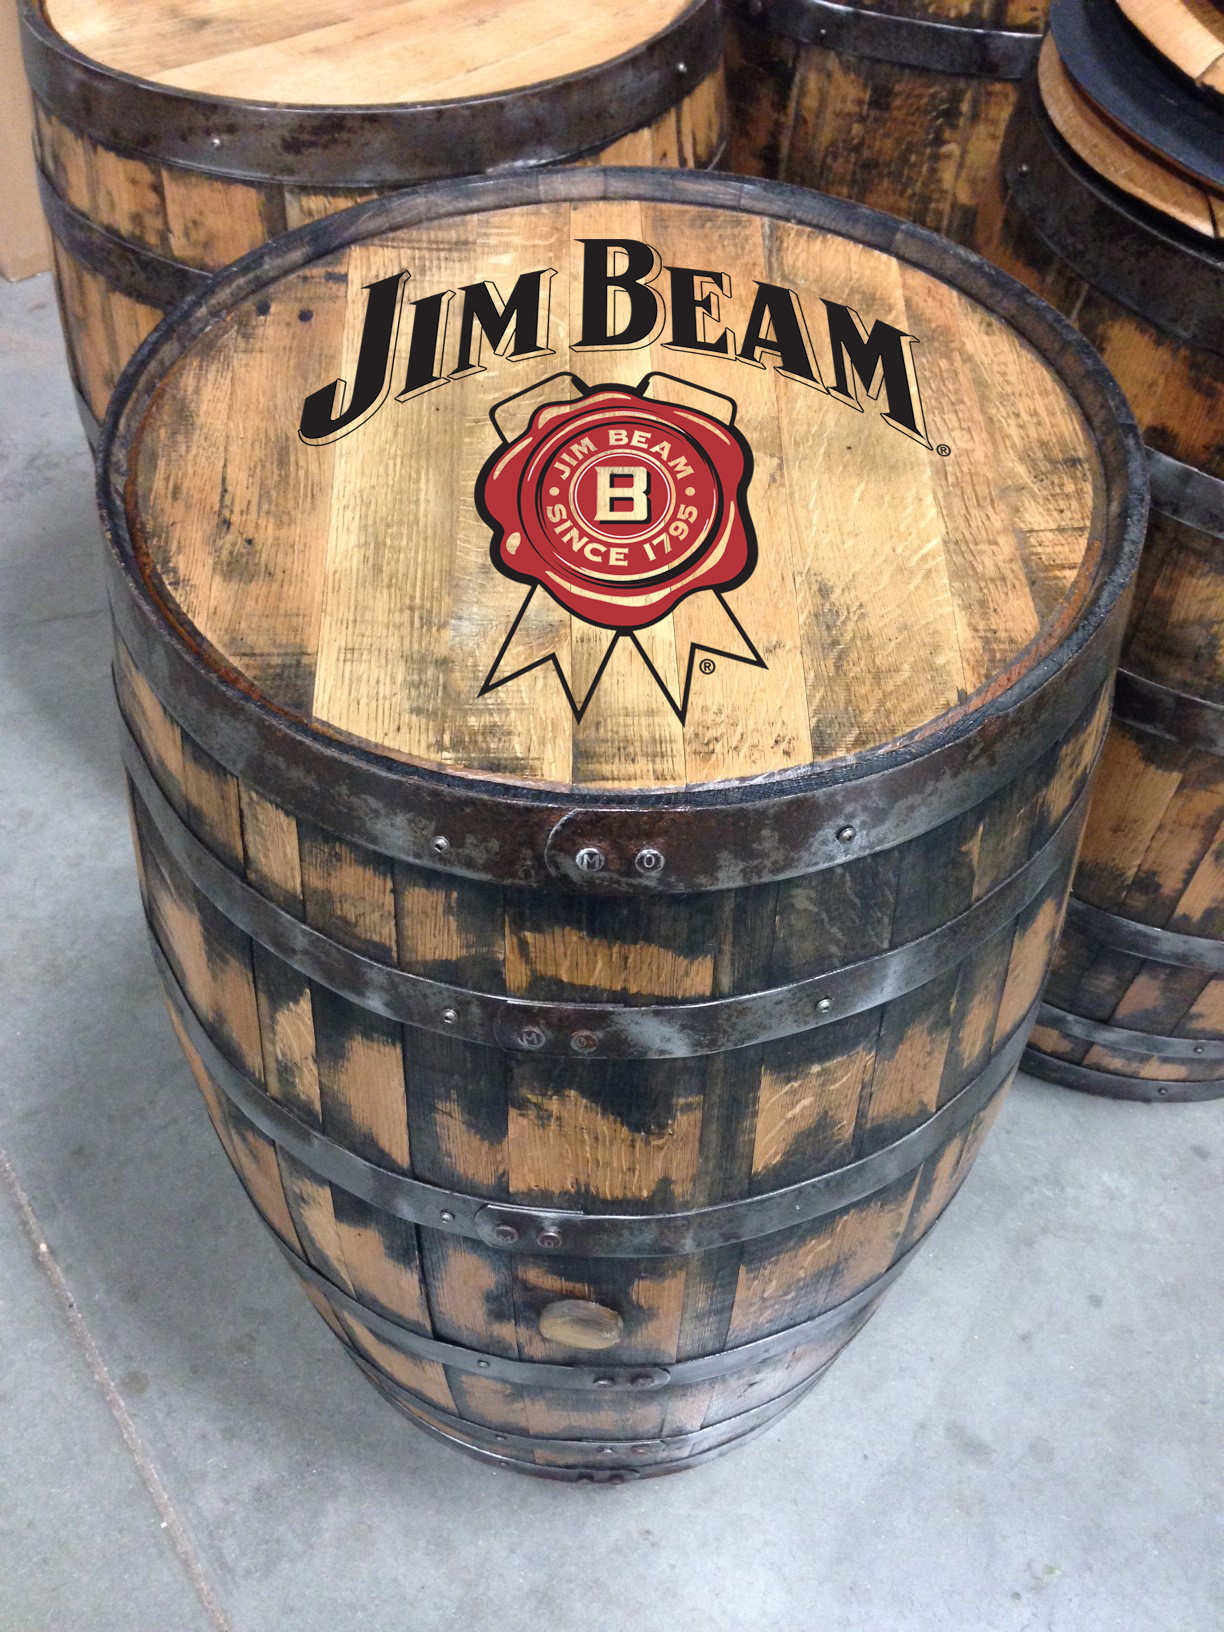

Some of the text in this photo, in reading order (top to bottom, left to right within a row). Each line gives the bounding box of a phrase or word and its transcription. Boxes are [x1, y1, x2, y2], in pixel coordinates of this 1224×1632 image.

[297, 267, 558, 446] JIM
[568, 238, 934, 450] BEAM
[553, 429, 695, 481] JIM BEAM
[593, 466, 652, 525] B
[546, 503, 698, 567] SINCE 1795
